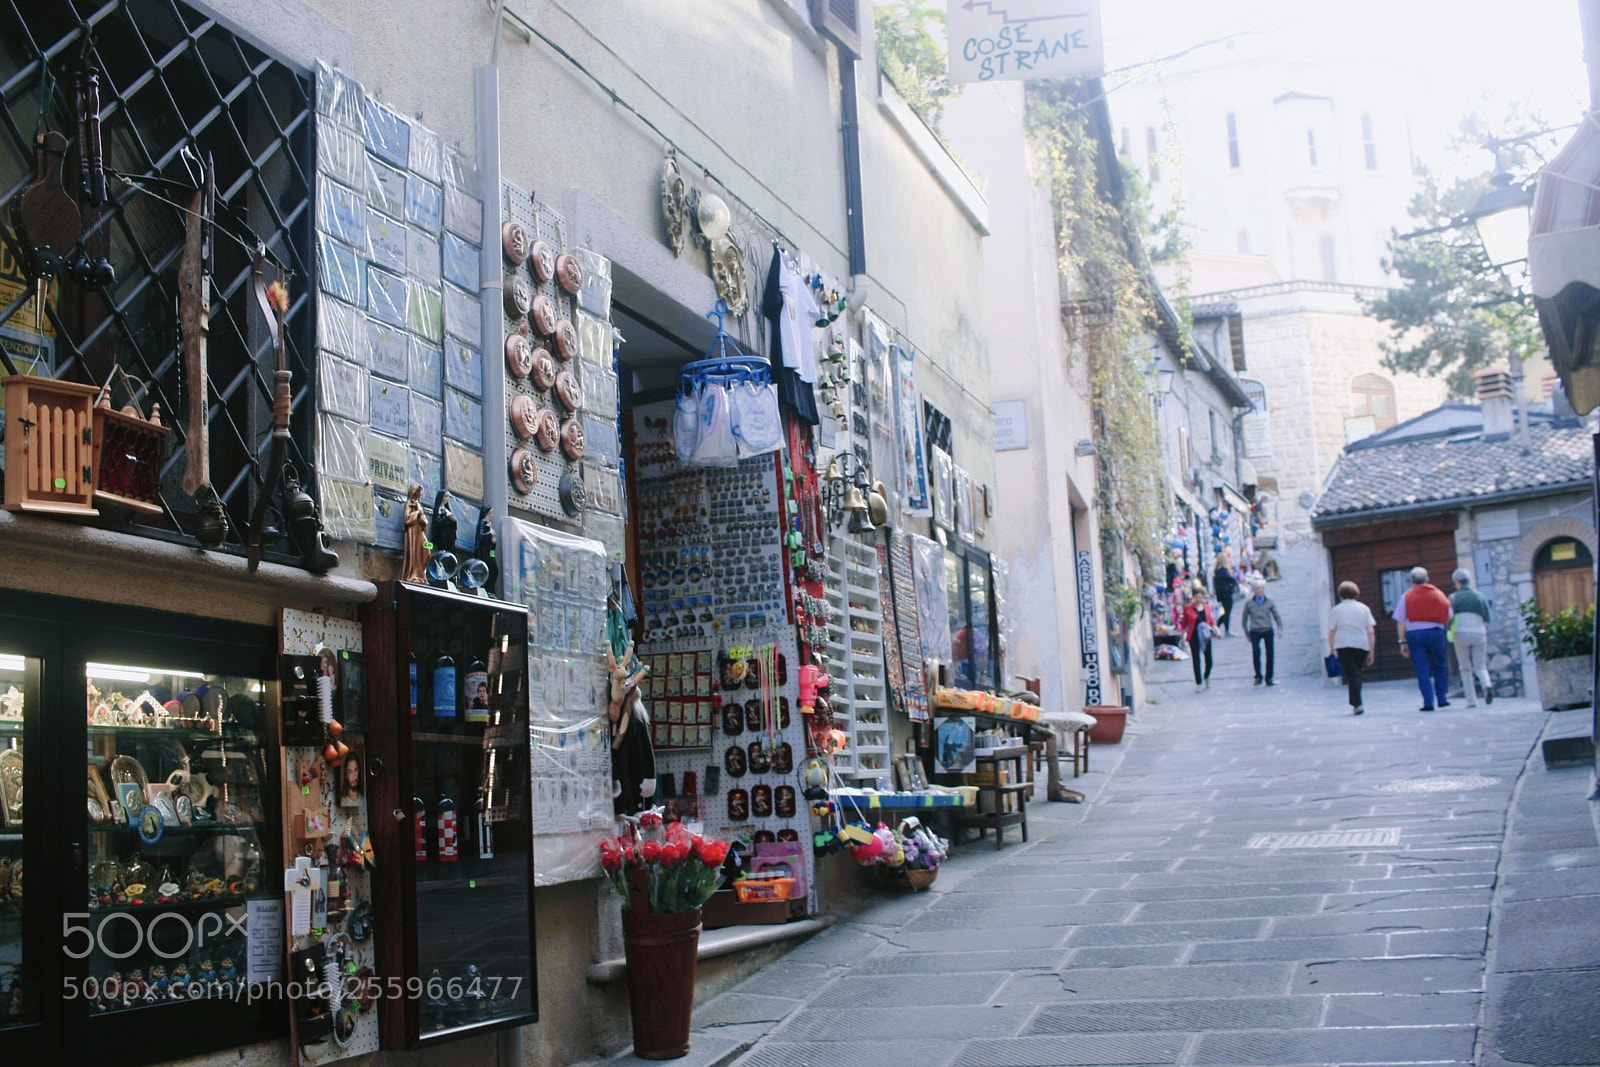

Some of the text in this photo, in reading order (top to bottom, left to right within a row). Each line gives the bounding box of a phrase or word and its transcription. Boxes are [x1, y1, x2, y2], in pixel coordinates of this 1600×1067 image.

[963, 23, 1032, 61] COSE
[978, 29, 1089, 81] STRANE
[369, 457, 405, 485] PRIVATO
[1078, 550, 1095, 652] PARRUCCHIERE
